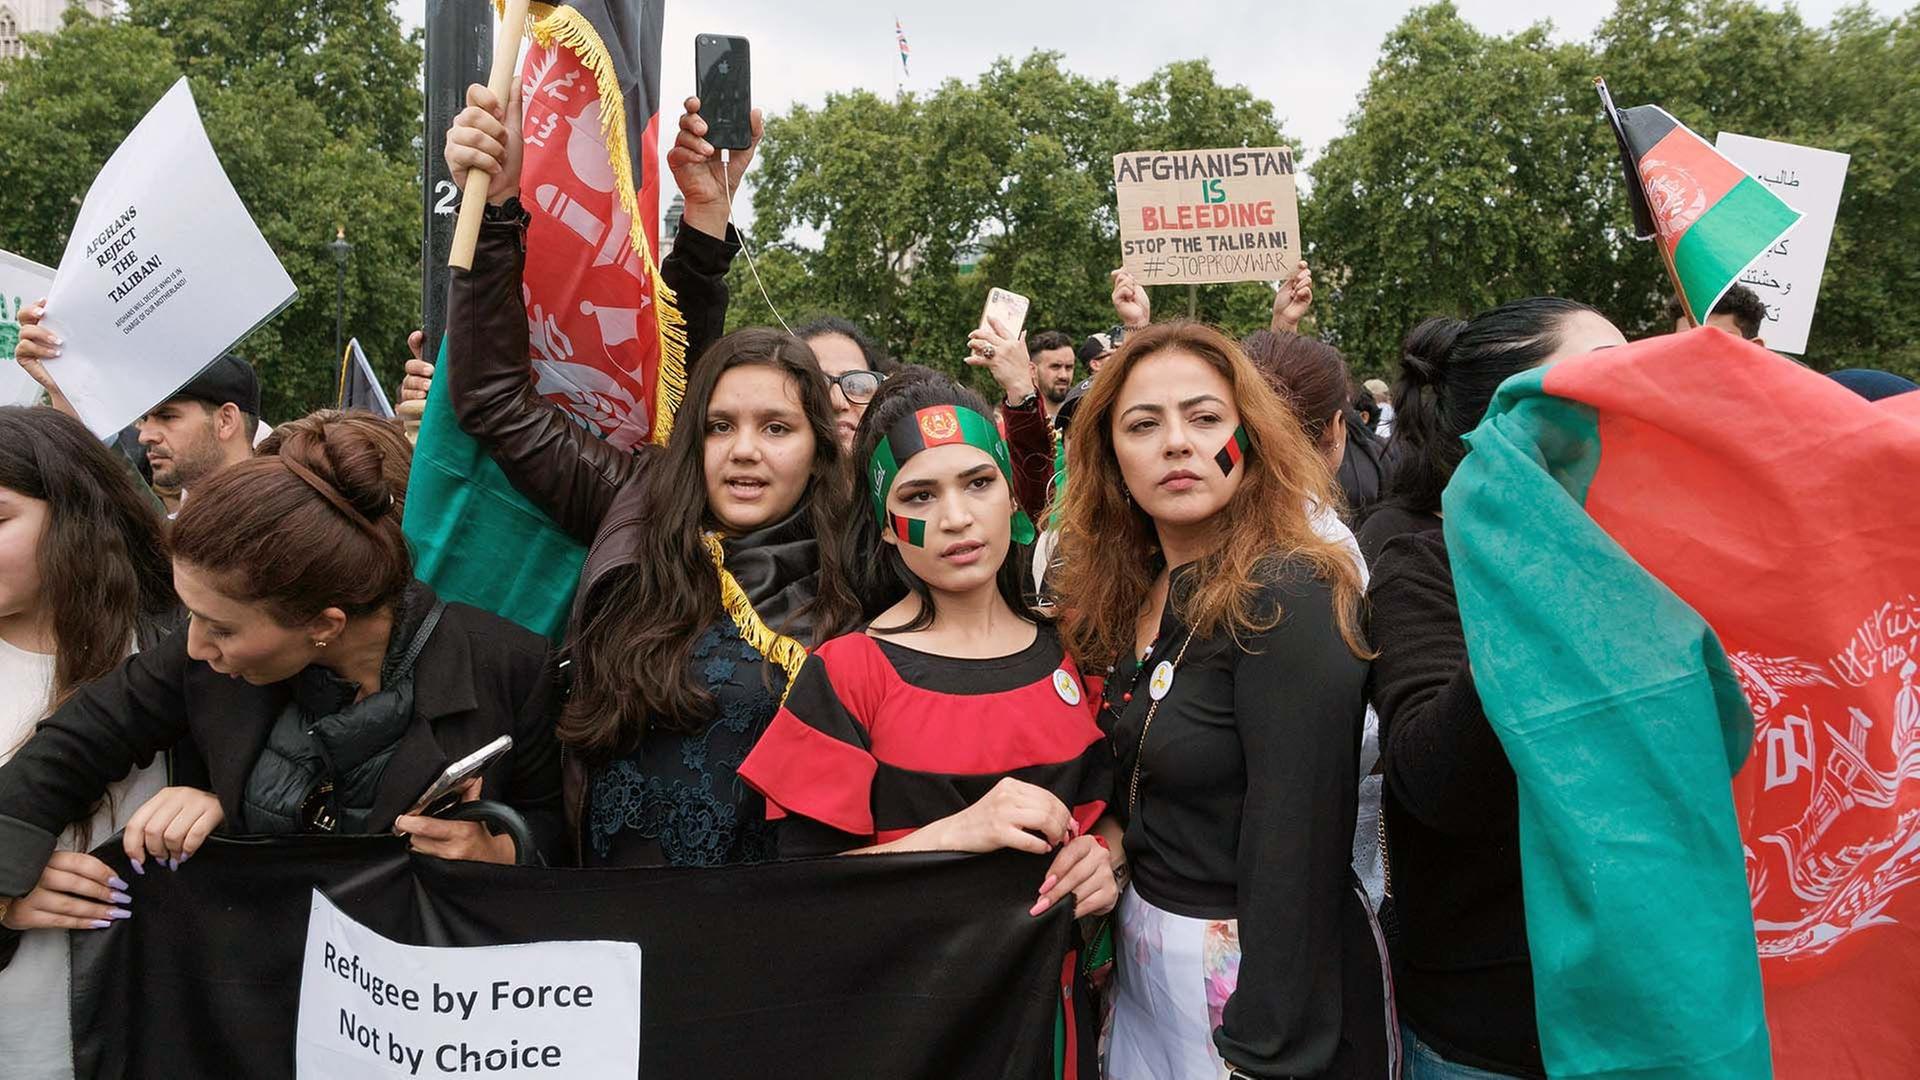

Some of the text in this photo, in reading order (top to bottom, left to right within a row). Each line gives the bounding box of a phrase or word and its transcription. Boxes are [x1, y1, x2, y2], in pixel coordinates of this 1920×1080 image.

[1117, 151, 1294, 183] AFGHANISTAN
[434, 180, 458, 216] 2
[1202, 179, 1226, 204] IS
[86, 205, 137, 258] AFGHANS
[1141, 201, 1275, 231] BLEEDING
[96, 226, 137, 268] REJECT
[1124, 231, 1288, 256] STOP THE TALIBAN!
[107, 254, 162, 304] TALIBAN!
[111, 250, 139, 276] THE
[1143, 252, 1289, 279] #STOPPROXYWAR
[323, 941, 594, 1021] Refugee by Force
[339, 1008, 563, 1076] Not by Choice
